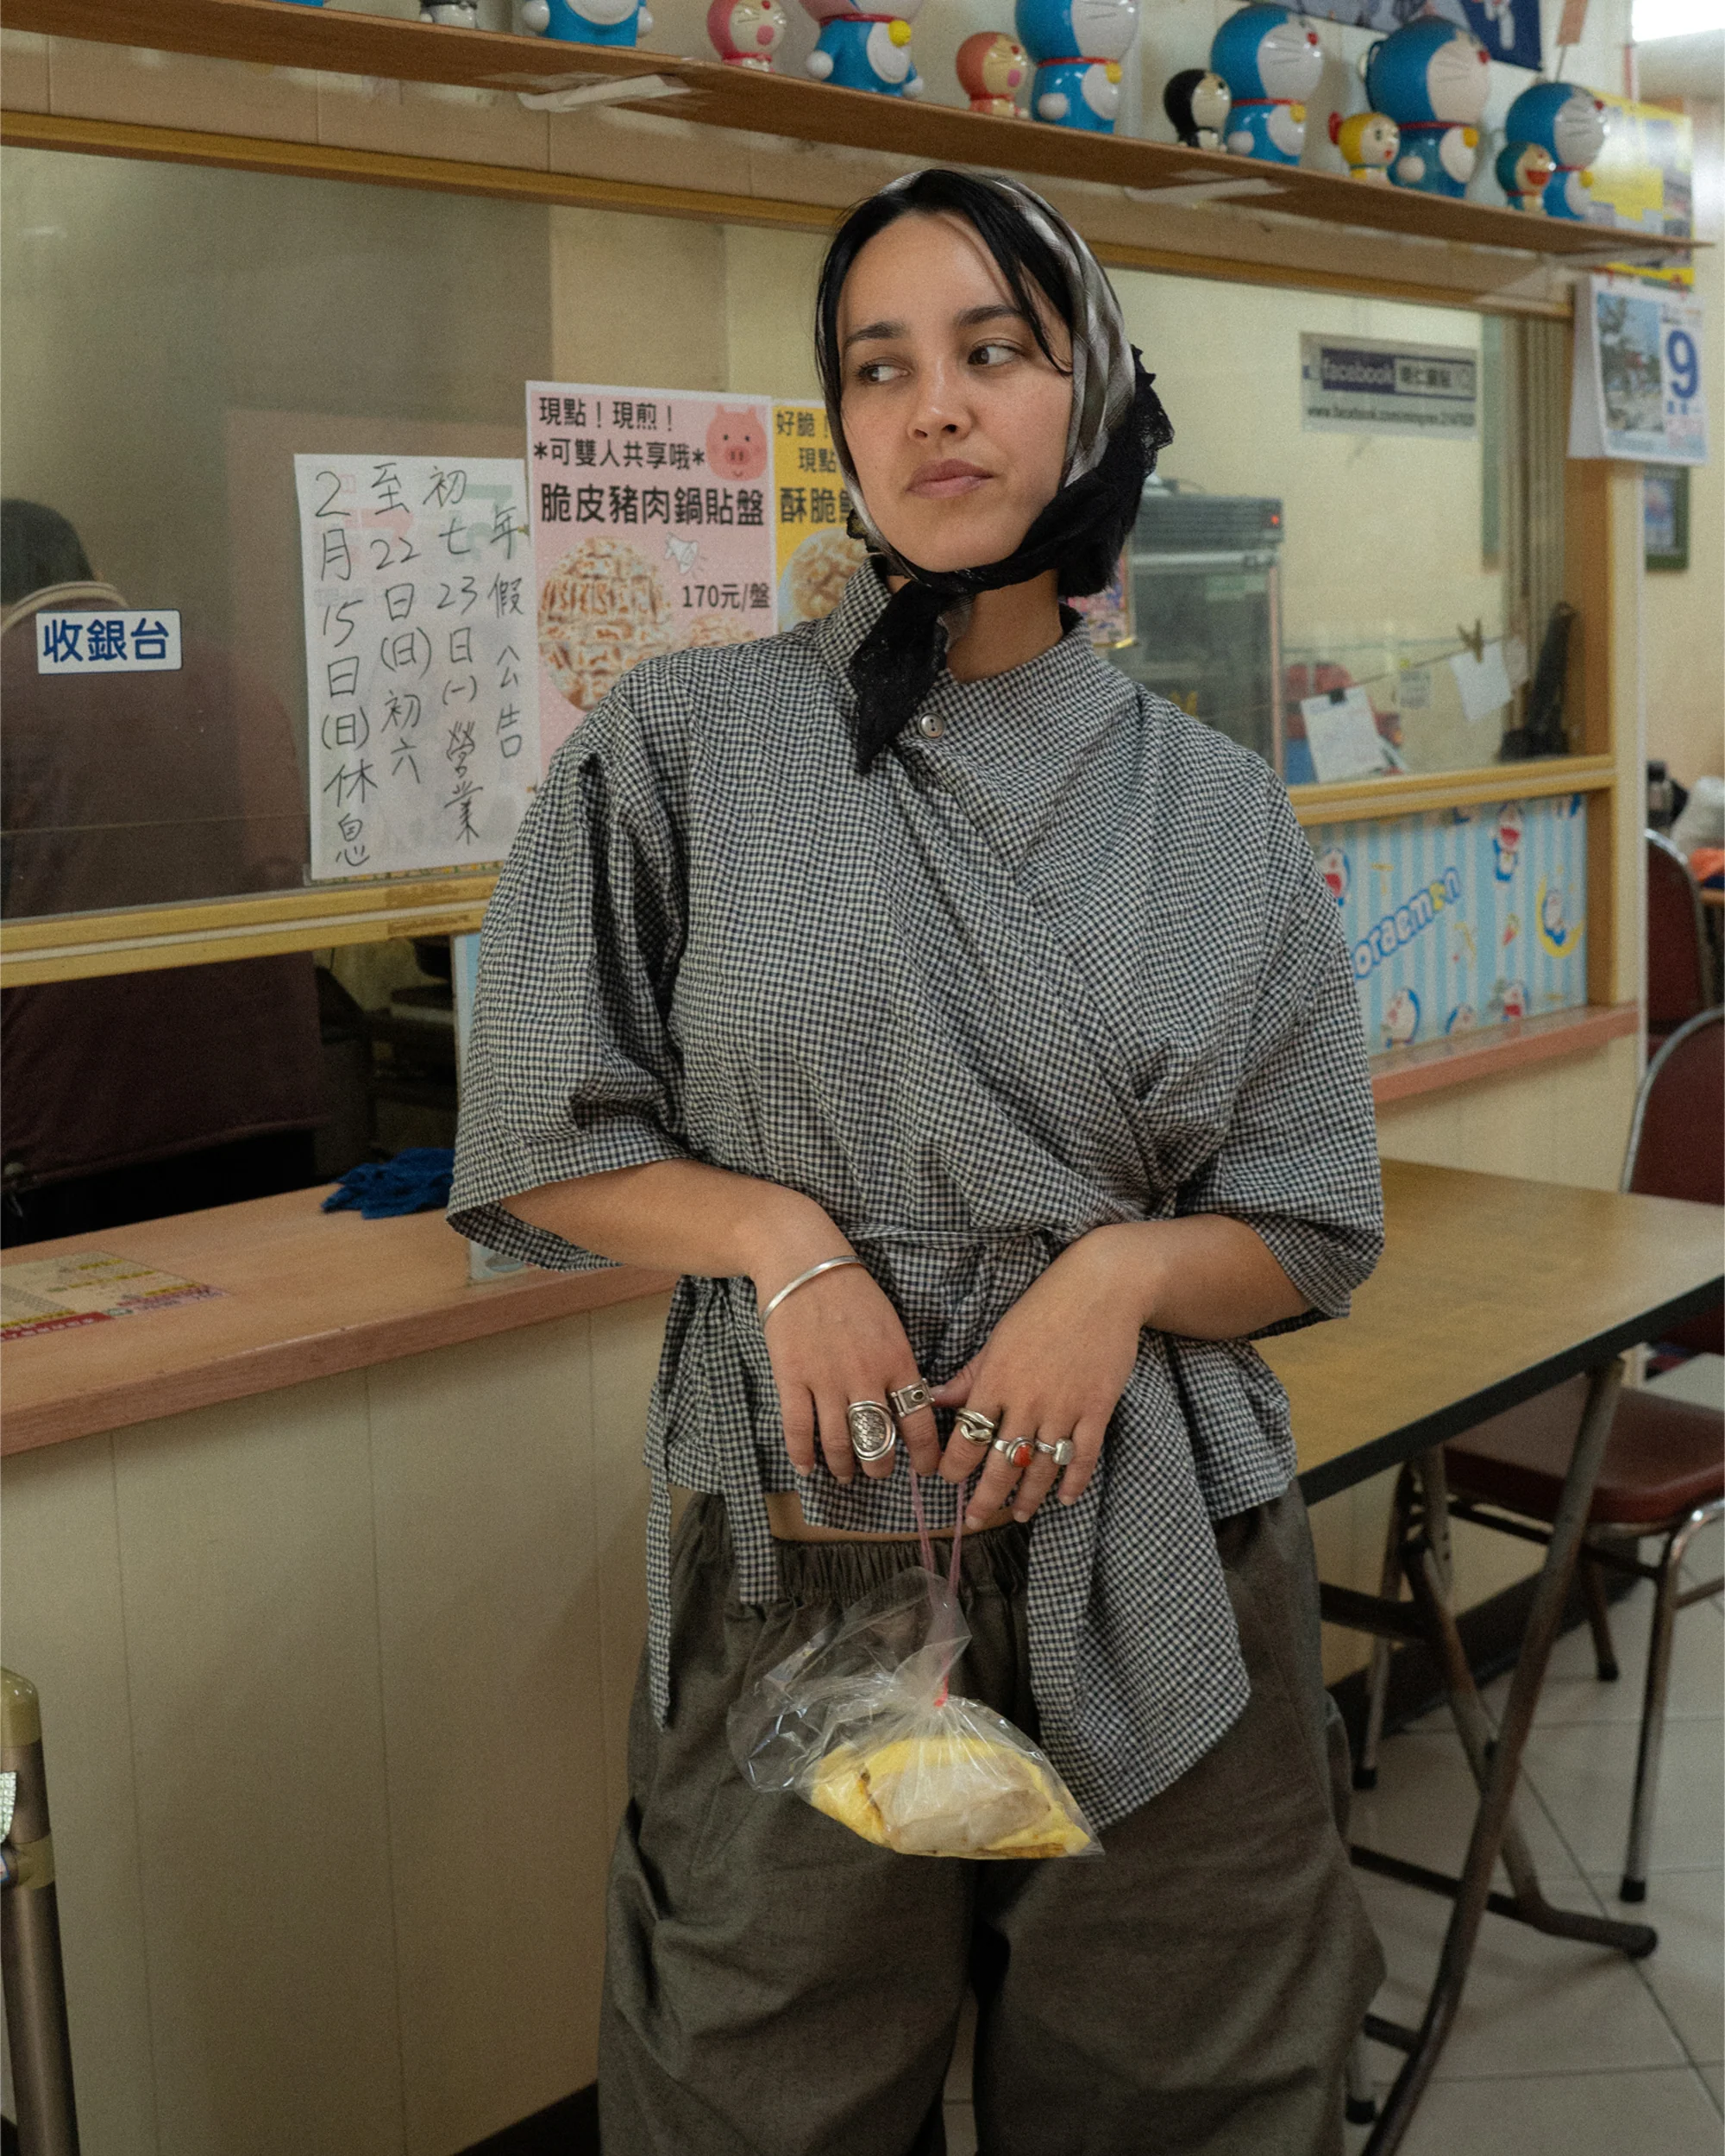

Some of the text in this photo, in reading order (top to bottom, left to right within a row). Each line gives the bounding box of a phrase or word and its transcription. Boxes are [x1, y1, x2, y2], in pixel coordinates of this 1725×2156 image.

[1666, 329, 1698, 399] 9
[538, 397, 673, 431] 現點！現煎！
[541, 482, 764, 526] 脆皮豬肉鍋貼盤
[682, 583, 770, 611] 170元/盤
[43, 617, 169, 663] 收銀台
[487, 505, 524, 759] 年假公告
